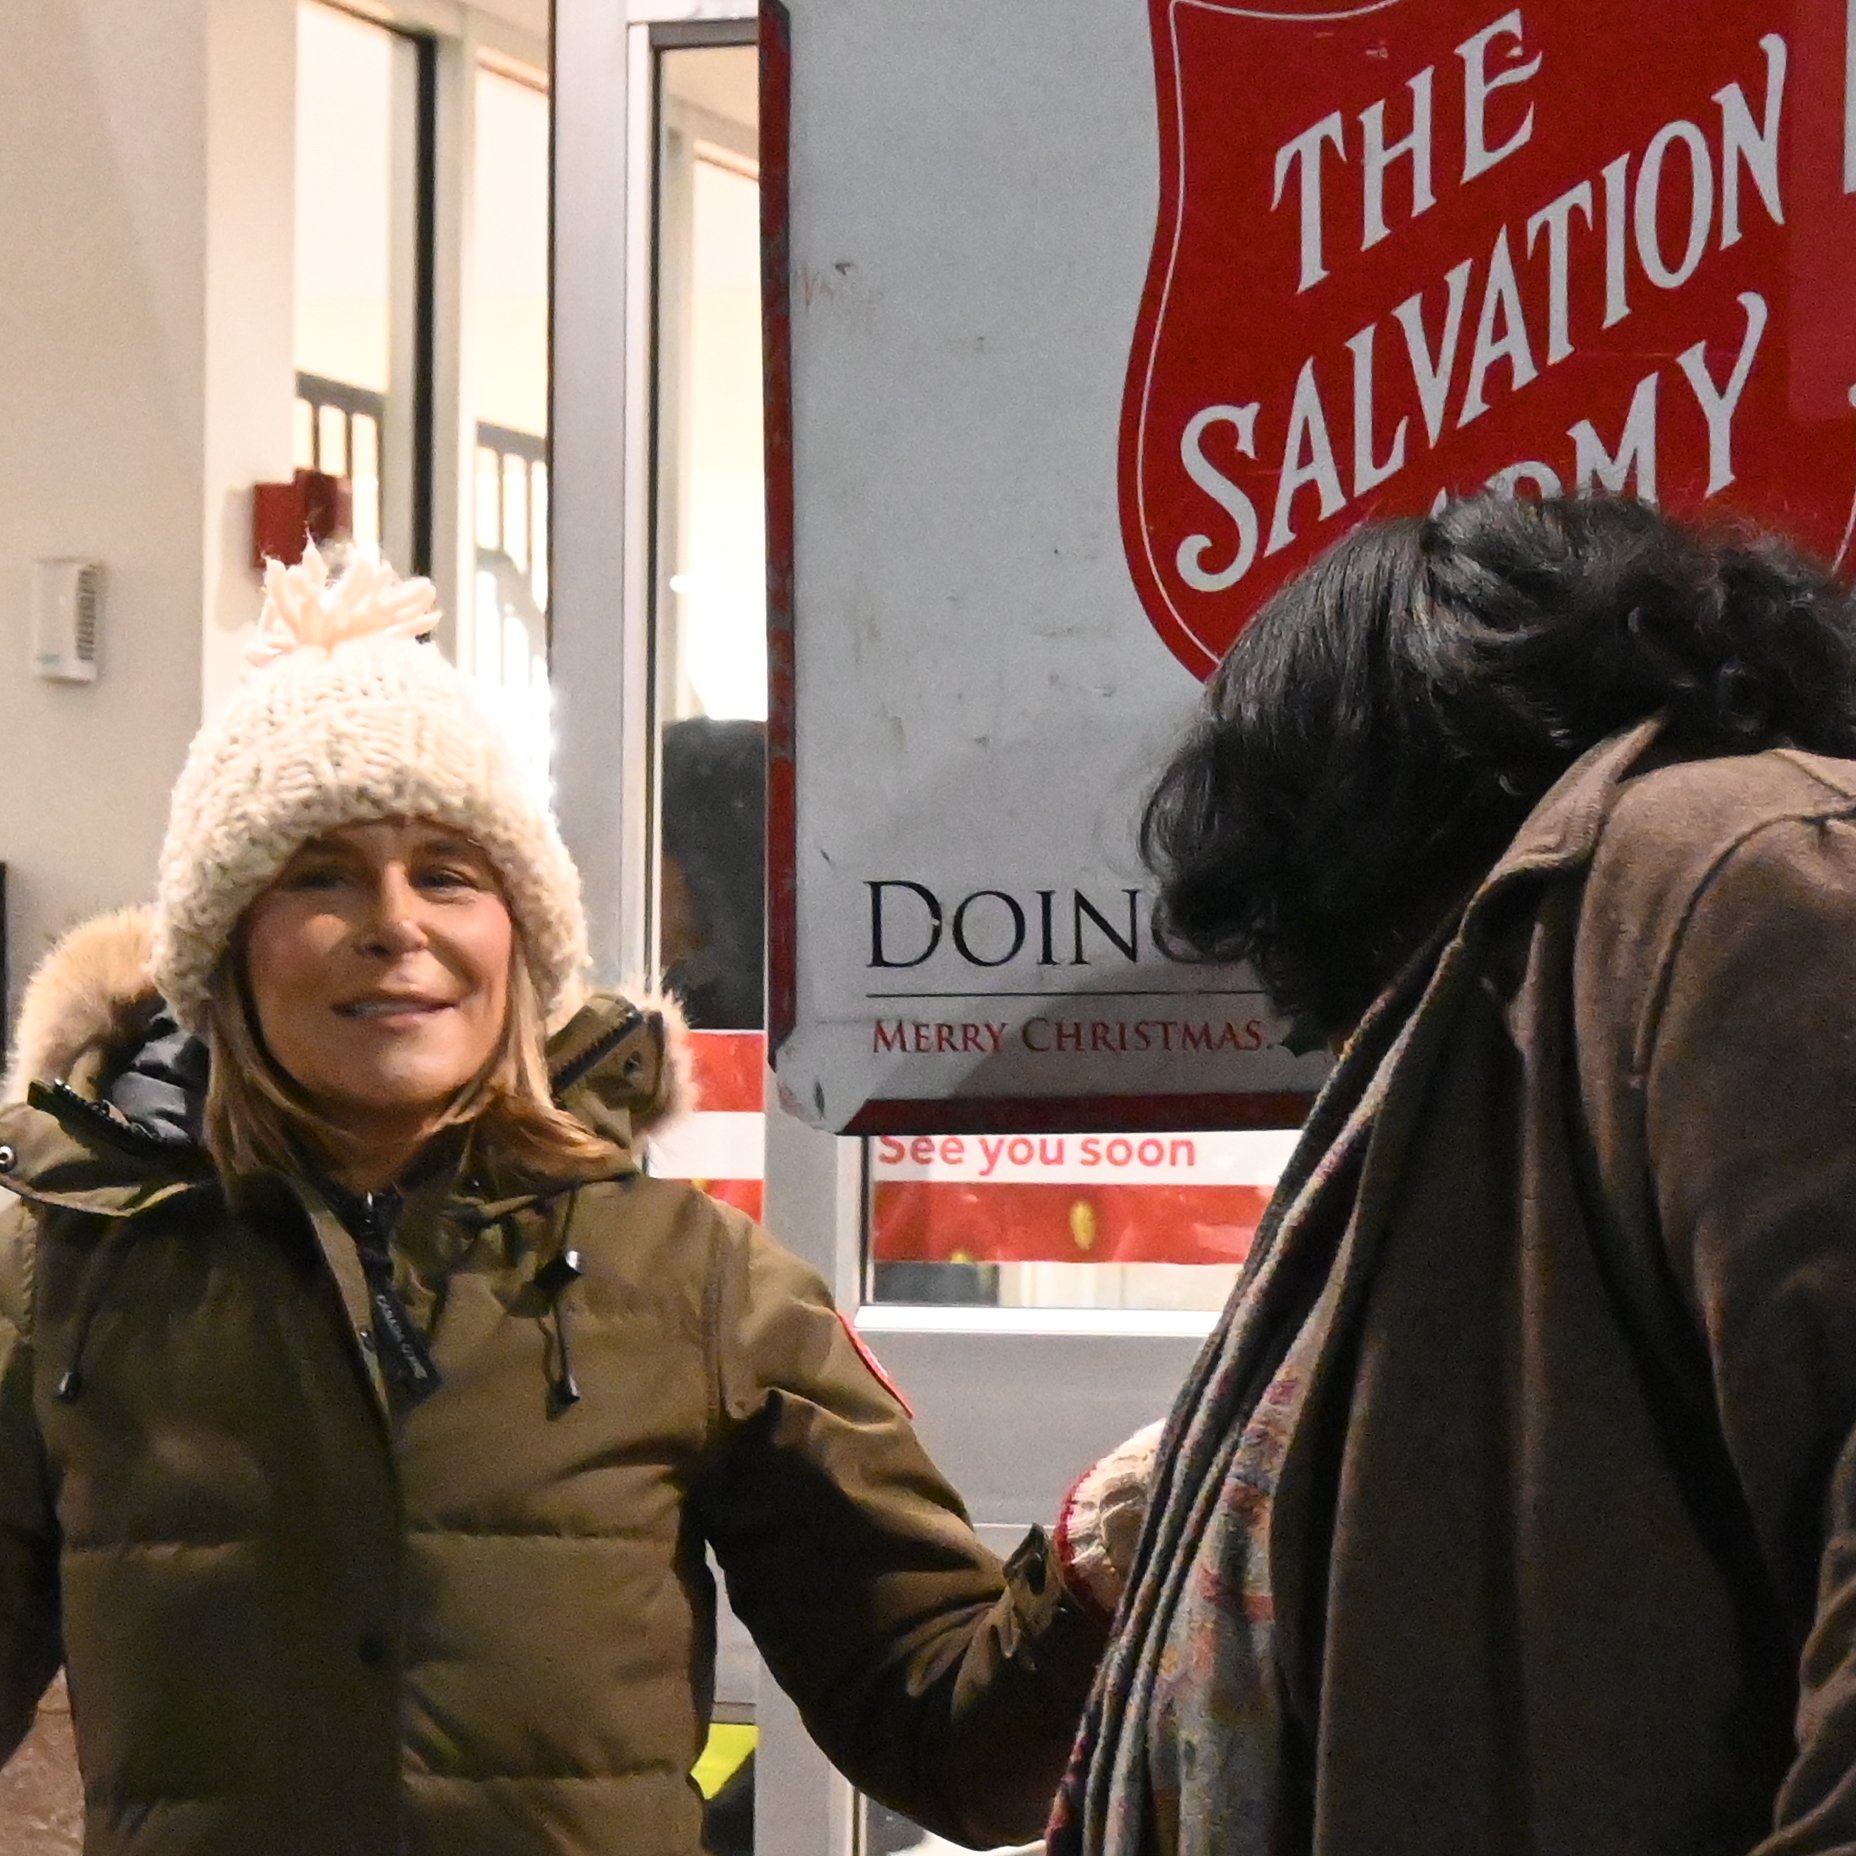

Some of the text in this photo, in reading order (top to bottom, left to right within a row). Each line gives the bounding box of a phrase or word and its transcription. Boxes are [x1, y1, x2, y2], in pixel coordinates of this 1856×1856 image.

[1270, 8, 1542, 294] THE
[1176, 32, 1787, 592] SALVATION
[873, 1018, 1007, 1054] MERRY
[878, 1135, 1195, 1176] See you soon
